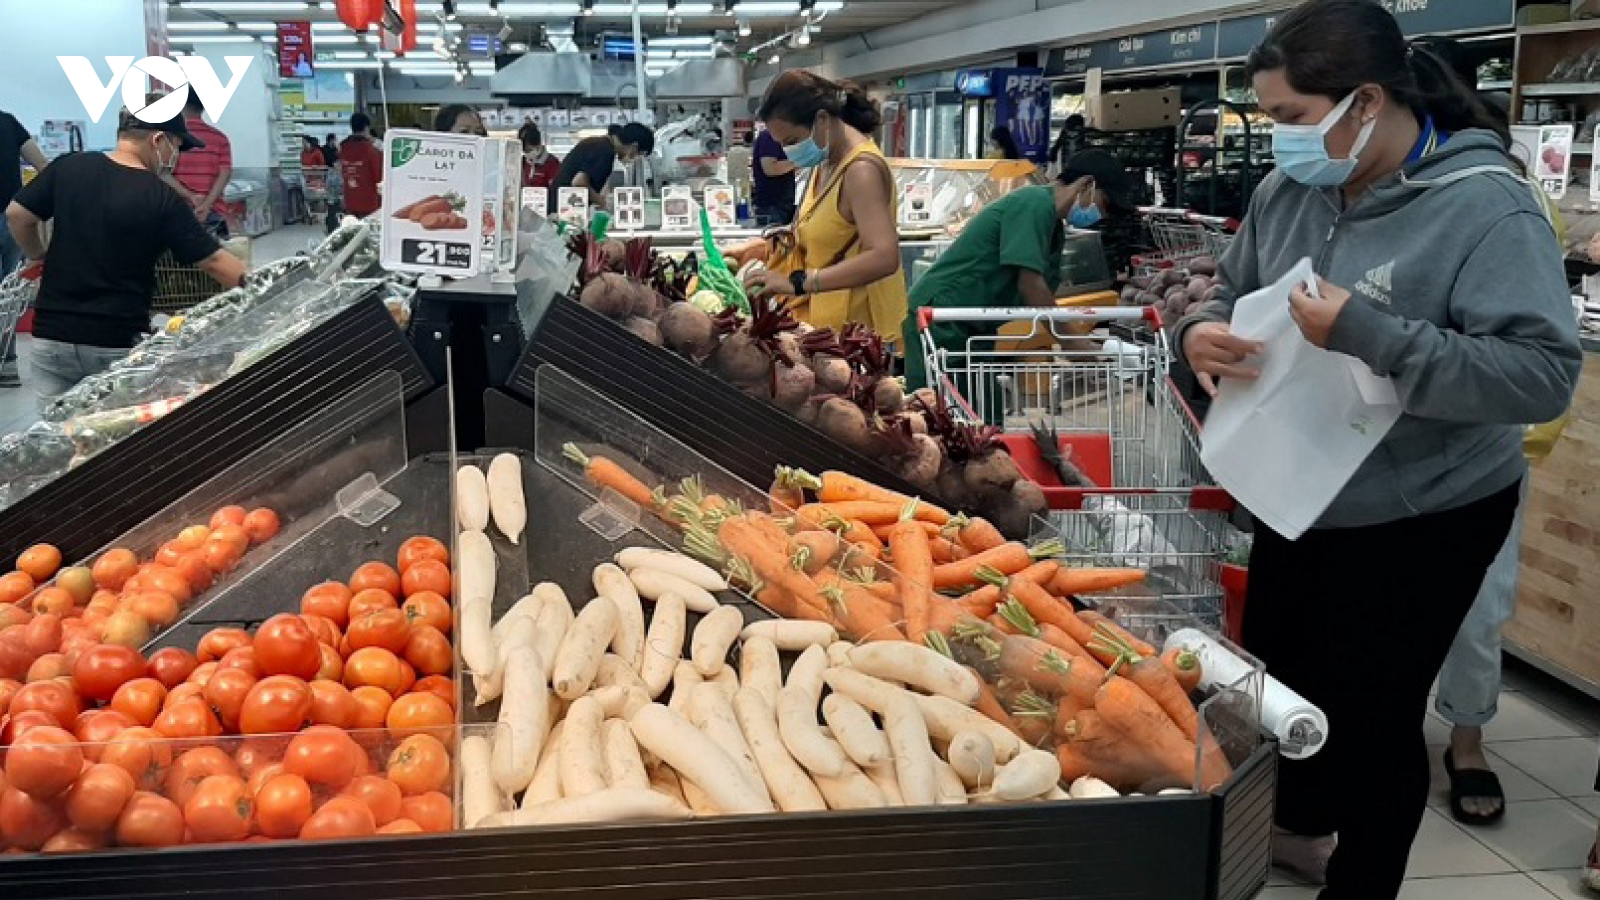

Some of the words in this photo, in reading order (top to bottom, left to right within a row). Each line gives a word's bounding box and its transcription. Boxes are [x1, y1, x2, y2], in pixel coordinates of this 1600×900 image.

[1170, 31, 1187, 45] Kim
[417, 147, 455, 158] CAROT
[1354, 280, 1392, 305] adidas
